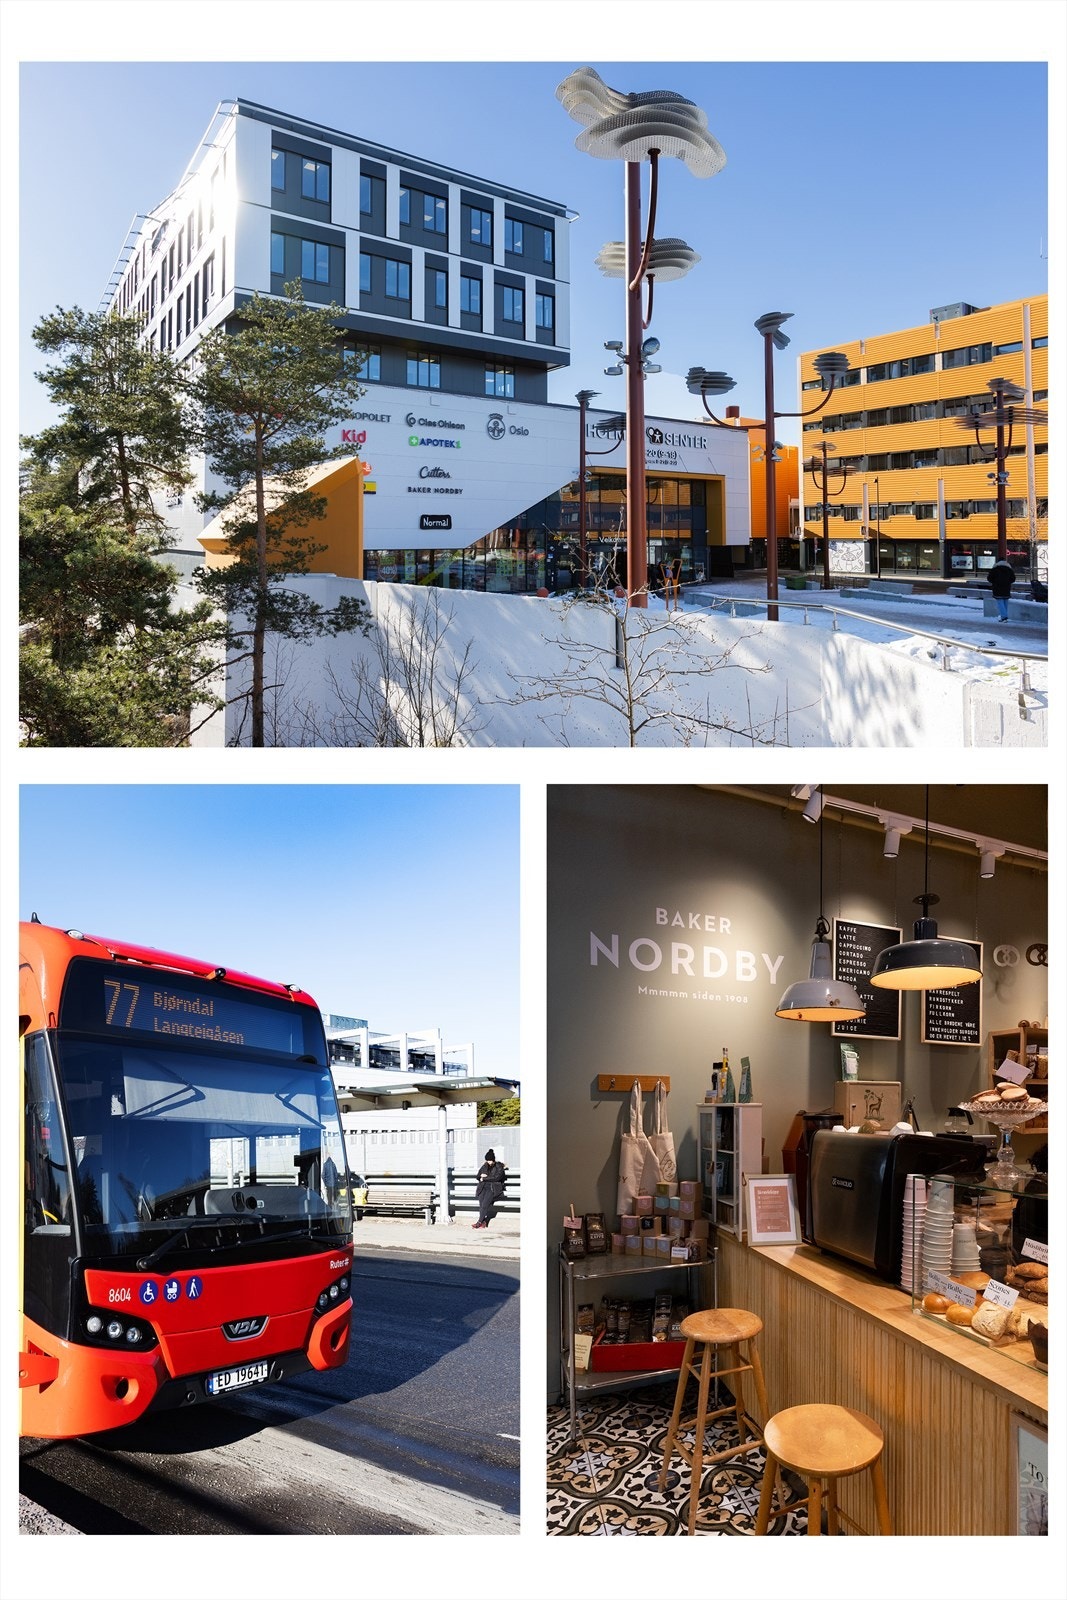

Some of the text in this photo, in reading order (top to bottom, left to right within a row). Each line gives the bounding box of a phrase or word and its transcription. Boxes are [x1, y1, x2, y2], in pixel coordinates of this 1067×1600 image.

[418, 417, 466, 430] Clas Ohlson
[341, 429, 367, 444] Kid
[509, 425, 530, 436] Oslo
[586, 423, 708, 450] HOLM SENTER
[407, 486, 464, 495] BAKER NORDBY
[423, 517, 449, 527] Normal
[655, 907, 733, 934] BAKER
[838, 926, 857, 934] KAFFE
[838, 933, 856, 941] LATTE
[838, 942, 872, 952] CAPPUCCINO
[590, 931, 785, 985] NORDBY
[838, 950, 864, 959] CORTADO
[838, 958, 867, 967] ESPRESSO
[838, 967, 871, 976] AMERICANO
[638, 985, 748, 1004] Mmmmm siden 1908
[104, 979, 214, 1028] 77 Bjørndal
[153, 1017, 245, 1045] Langteigåsen
[836, 1024, 857, 1032] JUICE
[108, 1287, 131, 1303] 8604
[228, 1319, 260, 1335] VDL
[217, 1371, 231, 1388] ED
[235, 1363, 265, 1383] 19641
